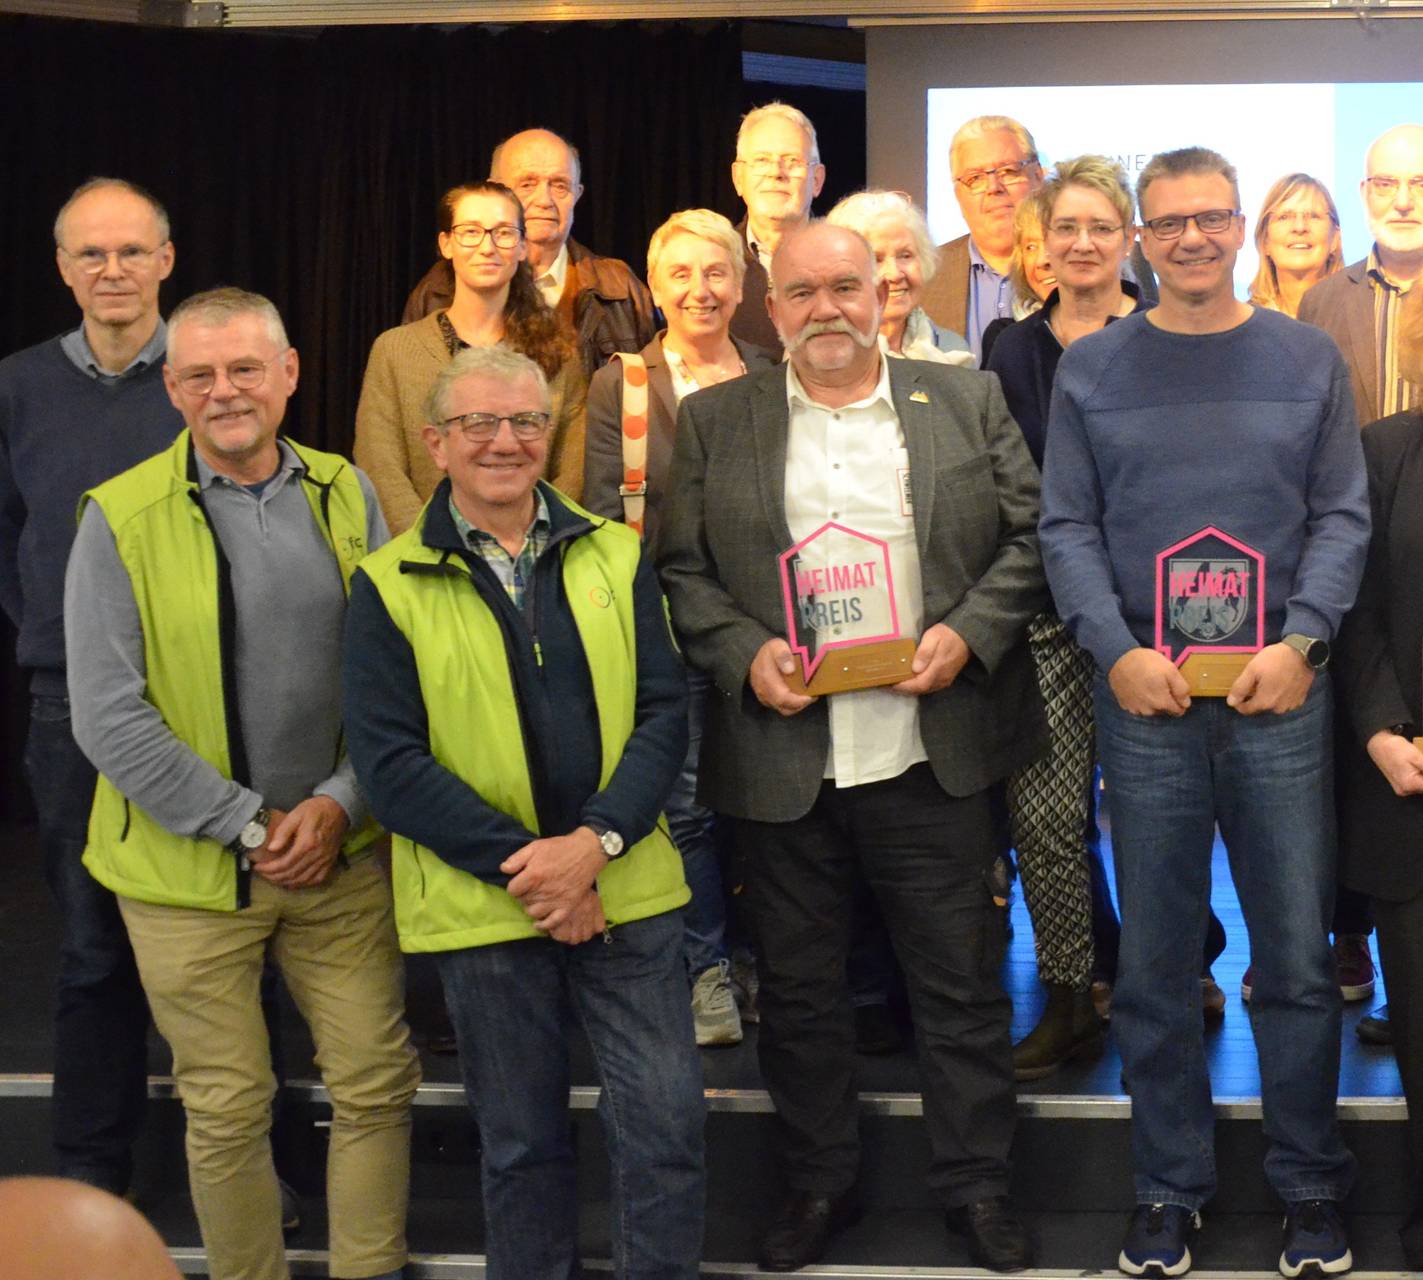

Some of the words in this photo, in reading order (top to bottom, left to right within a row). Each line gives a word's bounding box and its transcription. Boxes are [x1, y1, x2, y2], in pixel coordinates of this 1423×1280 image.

[796, 561, 876, 599] HEIMAT
[1169, 571, 1250, 598] HEIMAT
[799, 597, 863, 629] PREIS
